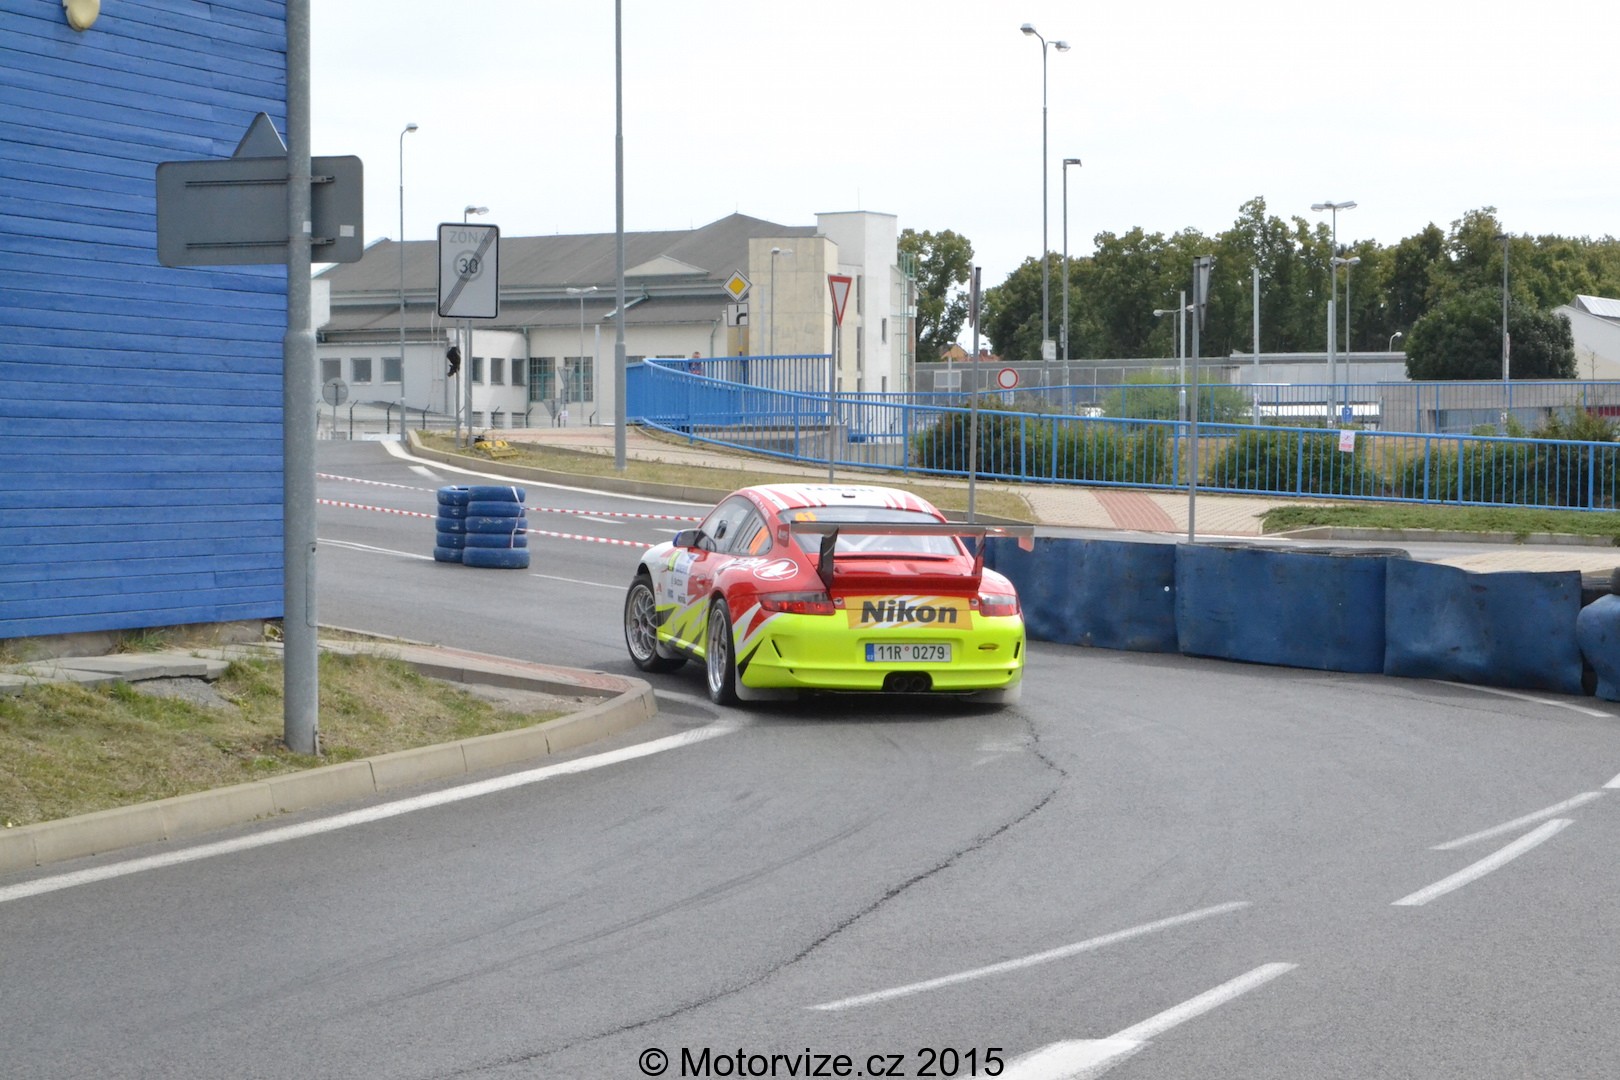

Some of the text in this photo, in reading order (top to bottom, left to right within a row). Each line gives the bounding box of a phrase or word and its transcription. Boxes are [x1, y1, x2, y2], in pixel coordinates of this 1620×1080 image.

[459, 258, 478, 274] 30
[861, 600, 957, 623] Nikon
[878, 645, 945, 660] 11R 0279
